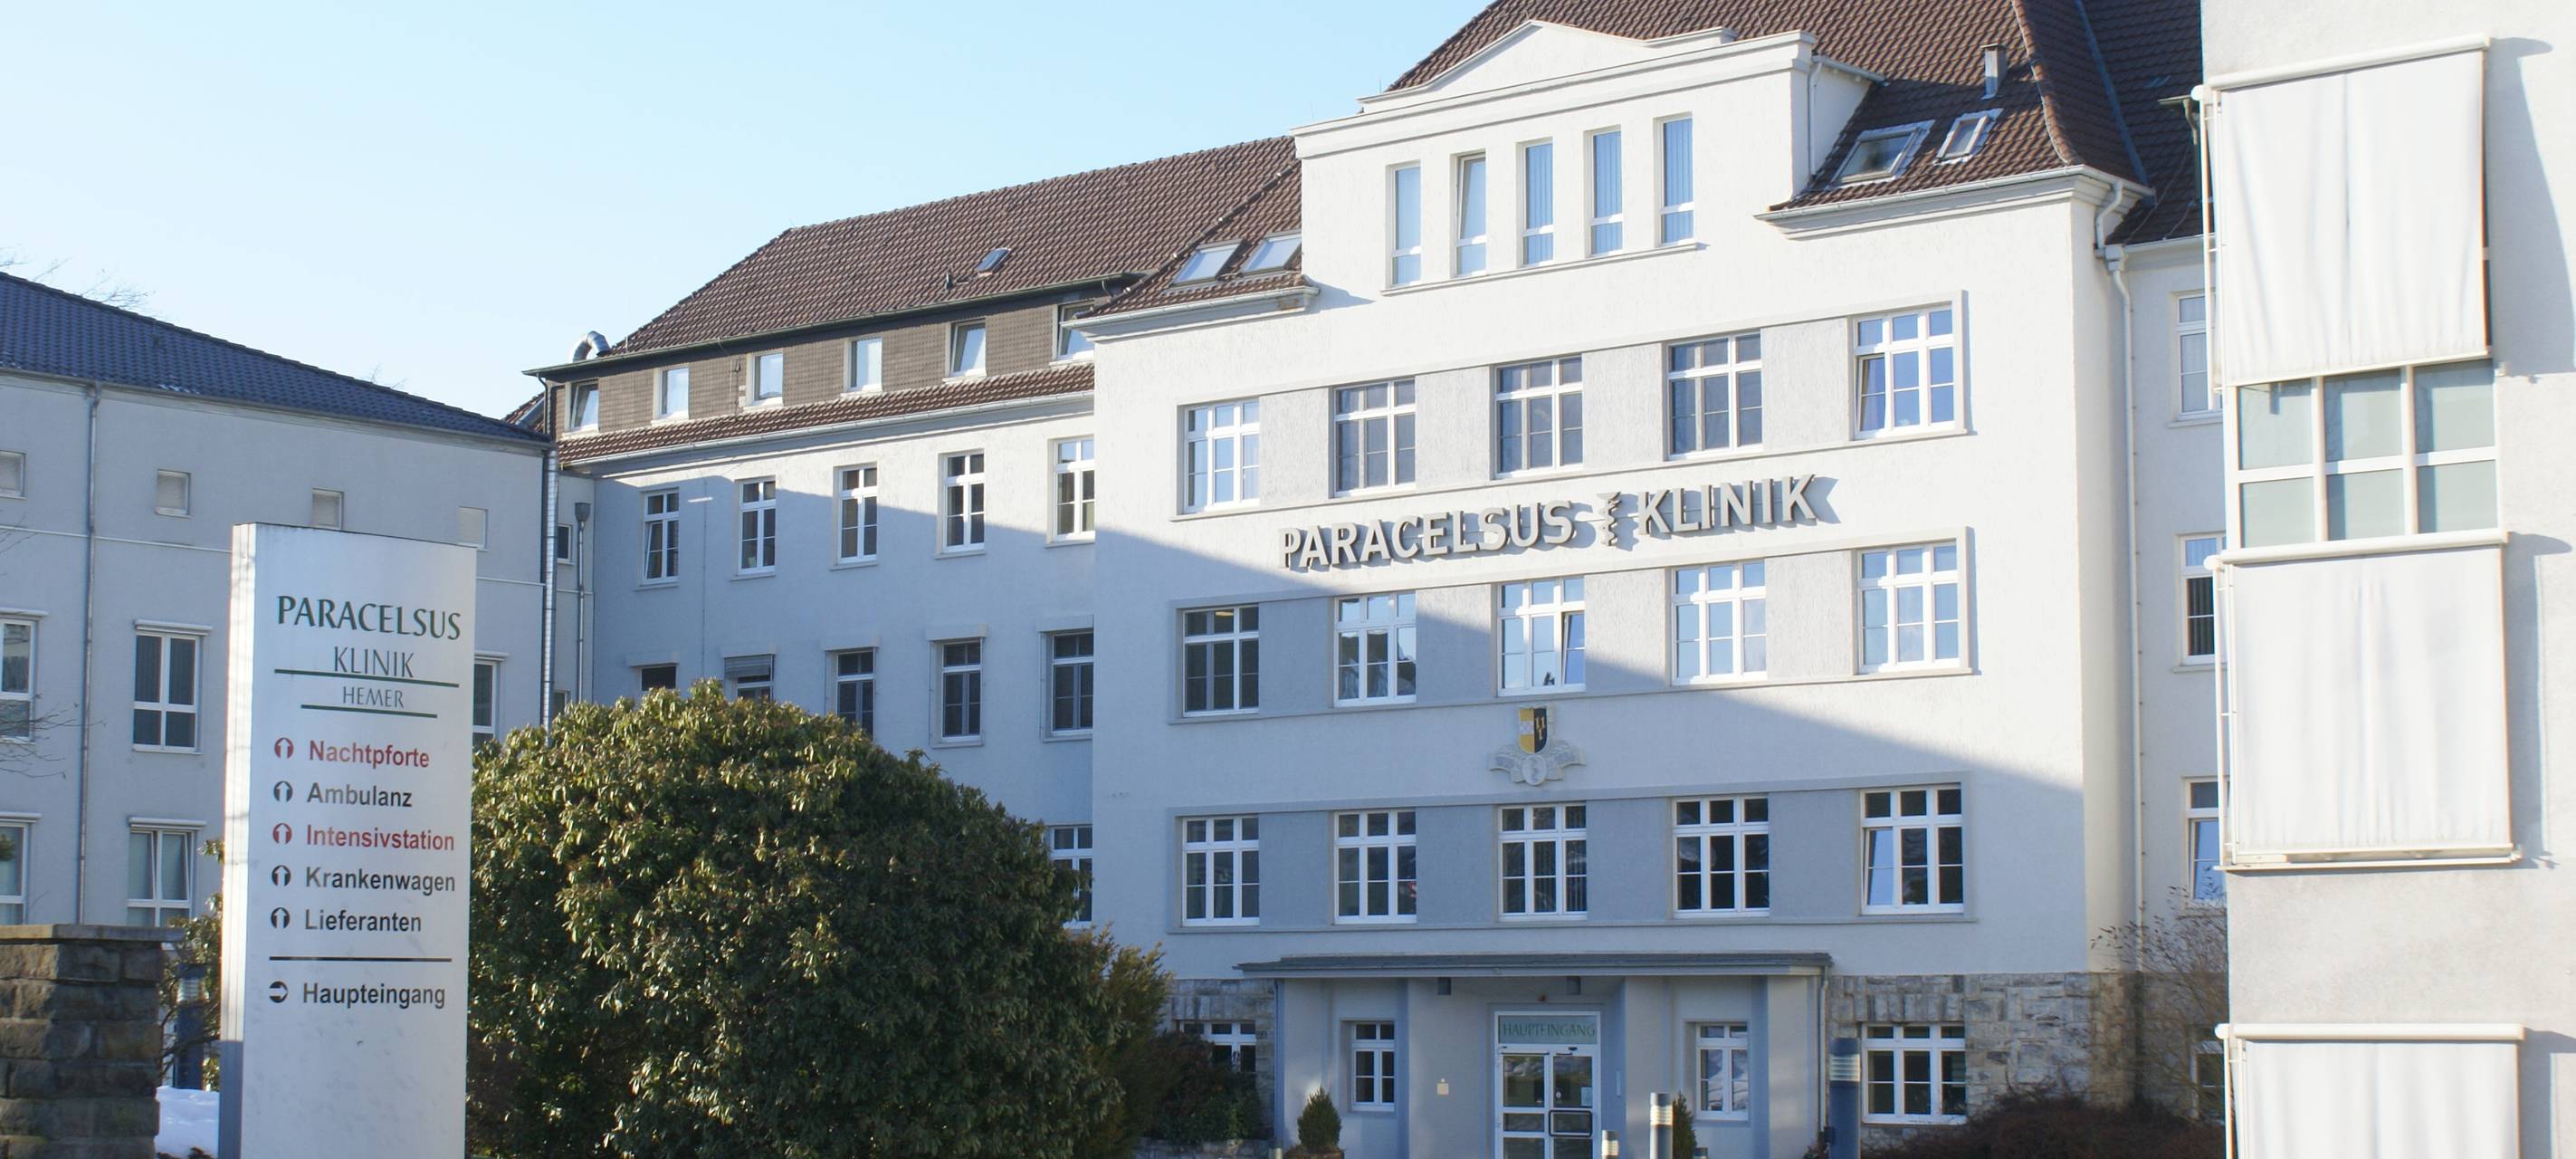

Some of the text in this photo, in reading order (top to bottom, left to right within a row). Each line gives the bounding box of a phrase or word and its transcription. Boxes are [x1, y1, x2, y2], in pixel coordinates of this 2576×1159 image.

[1278, 474, 1816, 569] PARACELSUS KLINIK
[277, 595, 461, 640] PARACELSUS
[334, 646, 415, 678] KLINIK
[342, 685, 405, 708] HEMER
[309, 739, 430, 769] Nachtpforte
[307, 781, 413, 808] Ambulanz
[306, 823, 454, 851] Intensivstation
[305, 866, 455, 896] Krankenwagen
[304, 908, 422, 932] Lieferanten
[302, 982, 445, 1010] Haupteingang
[1503, 1022, 1596, 1038] HAUPTEINGANG
